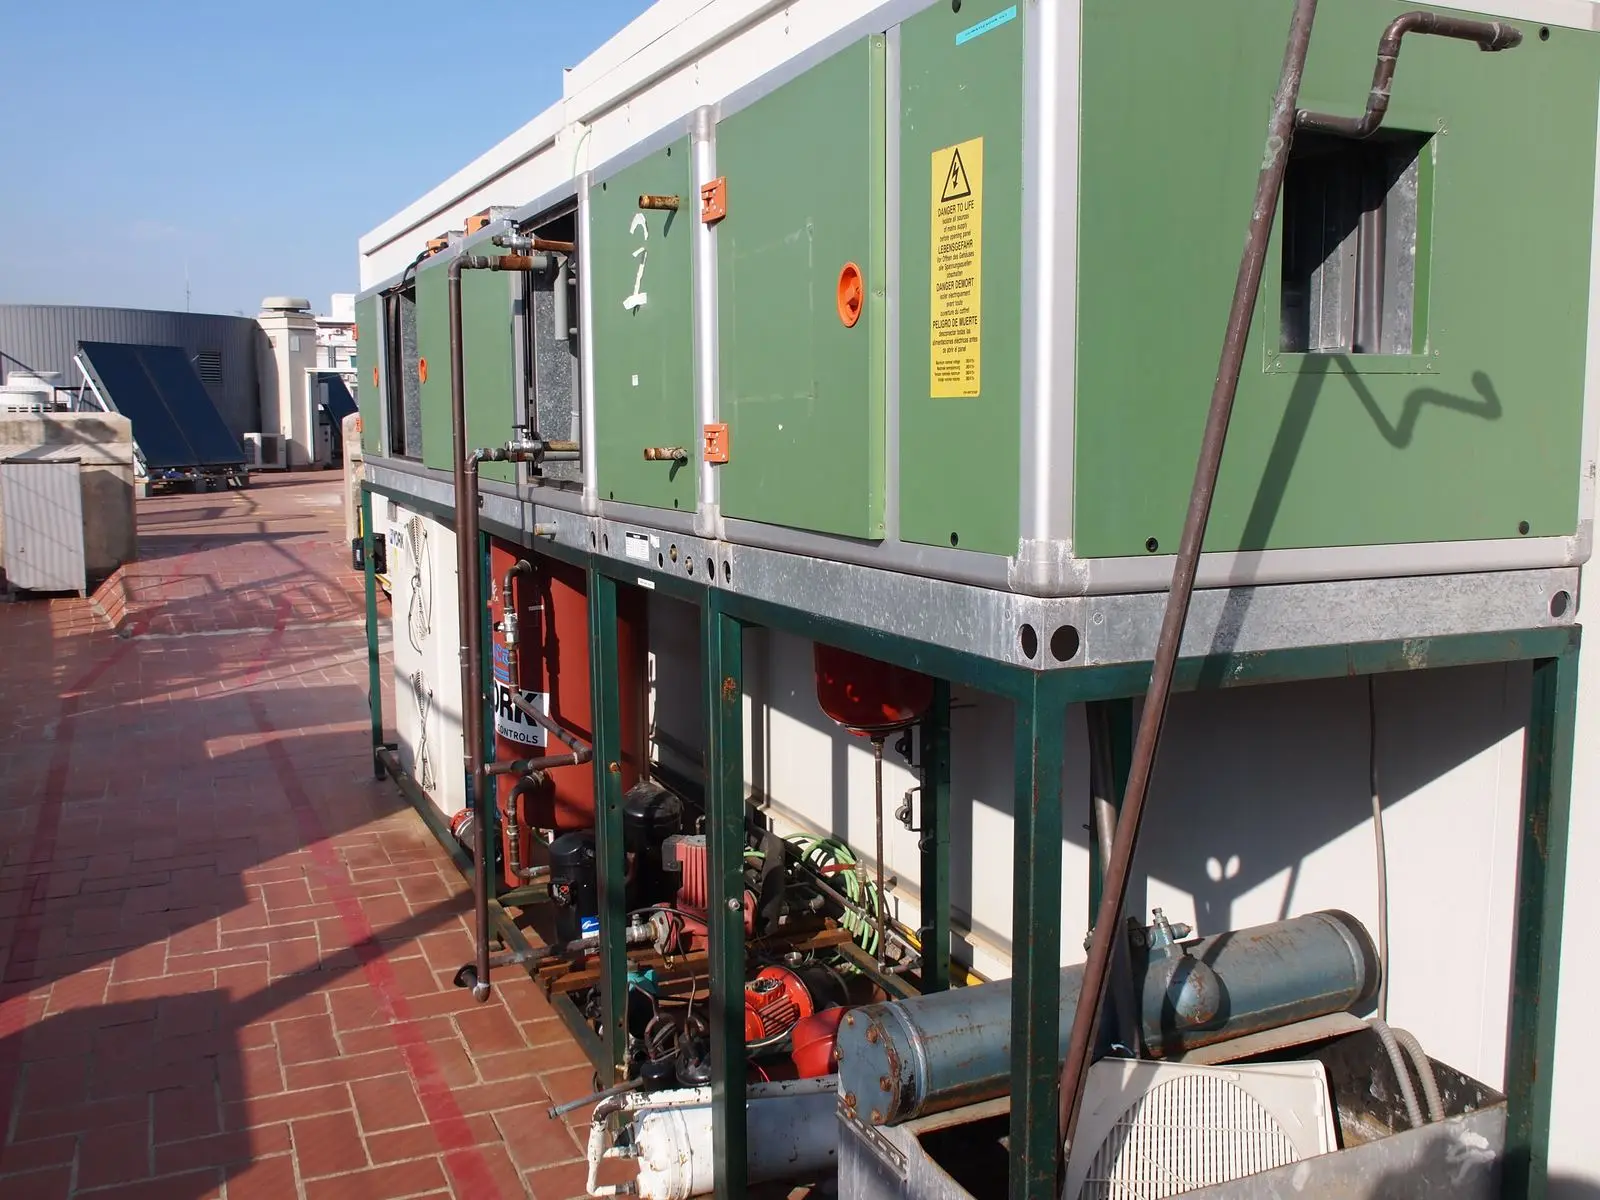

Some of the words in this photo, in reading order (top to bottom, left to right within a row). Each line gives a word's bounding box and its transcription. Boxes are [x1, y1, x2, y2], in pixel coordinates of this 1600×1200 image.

[938, 204, 956, 217] DANGER
[957, 202, 963, 212] TO
[965, 199, 974, 211] LIFE
[938, 239, 973, 254] LEBENSGEFAHR
[936, 280, 954, 292] DANGER
[933, 318, 951, 329] PELIGRO
[952, 317, 958, 327] DE
[959, 315, 977, 326] MUERTE
